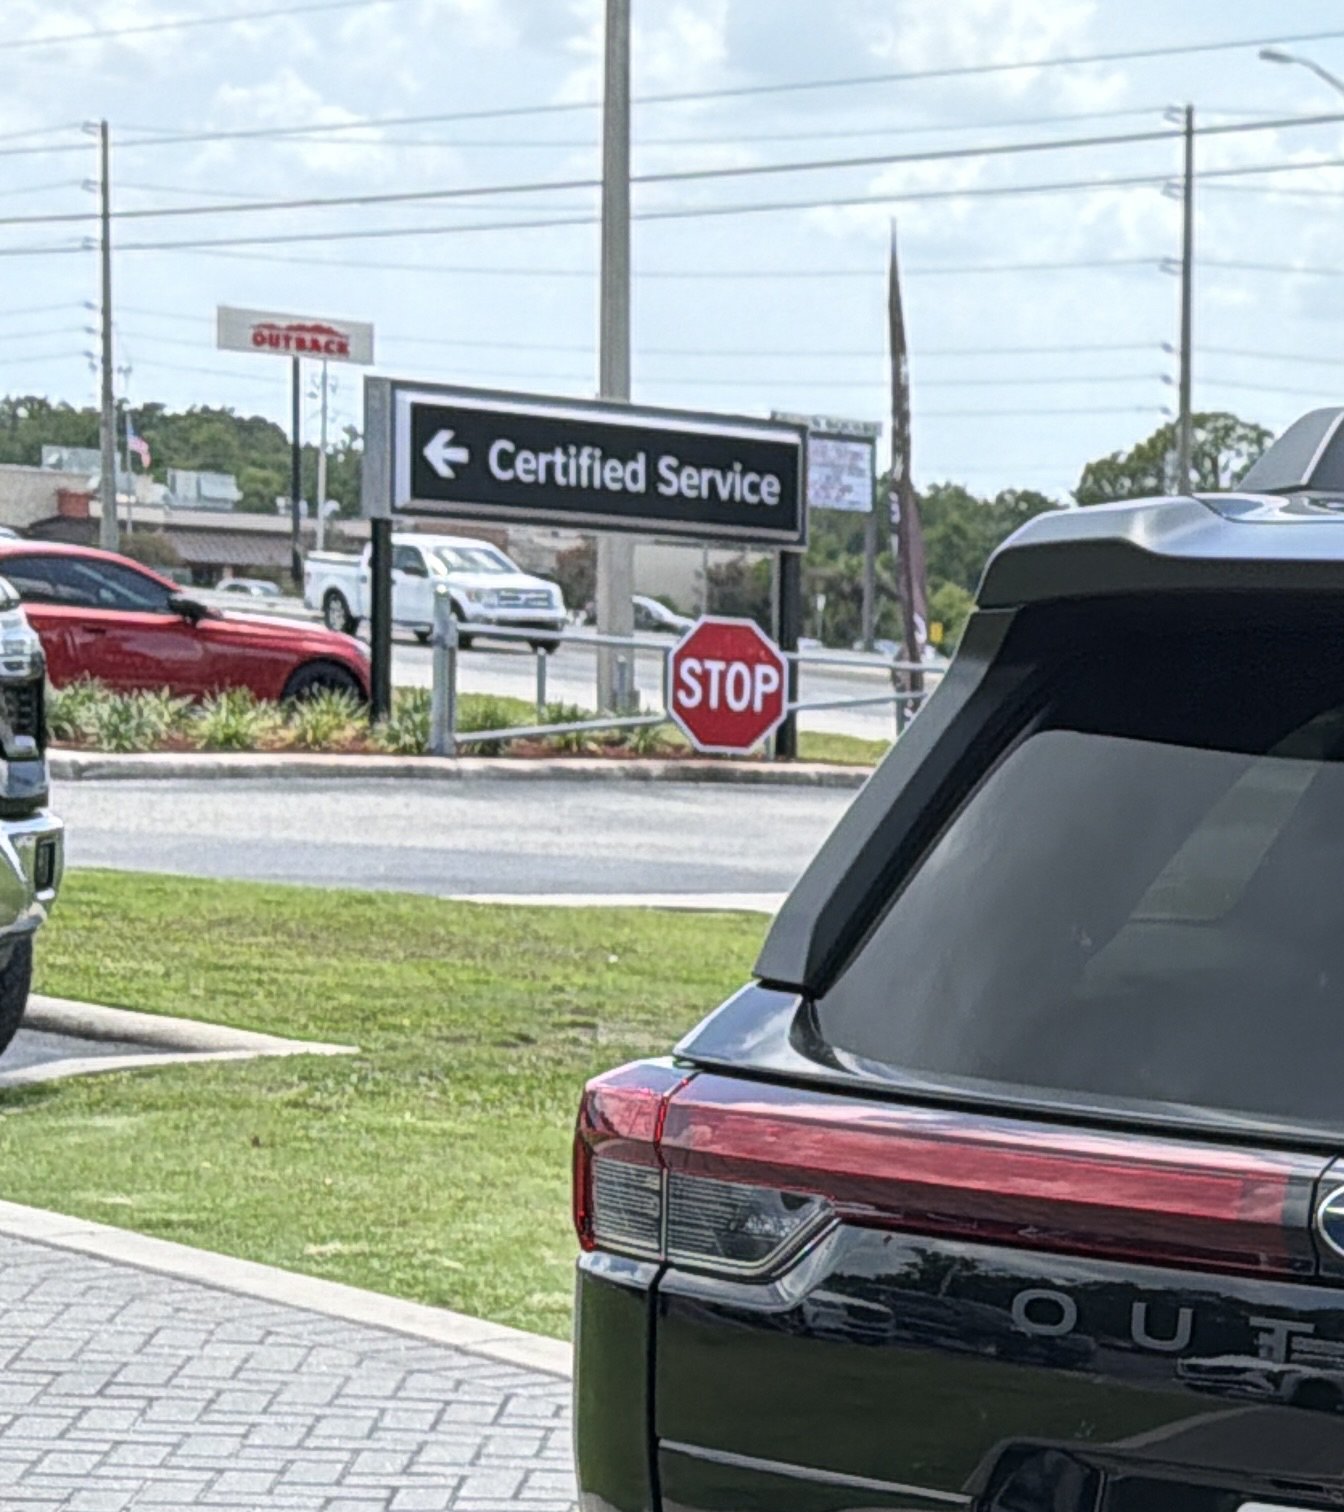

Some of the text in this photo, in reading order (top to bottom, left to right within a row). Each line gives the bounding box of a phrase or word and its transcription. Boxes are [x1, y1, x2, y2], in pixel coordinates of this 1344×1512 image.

[252, 331, 349, 354] OUTBACK
[489, 439, 646, 493] Certified
[657, 455, 781, 505] Service
[677, 657, 780, 713] STOP
